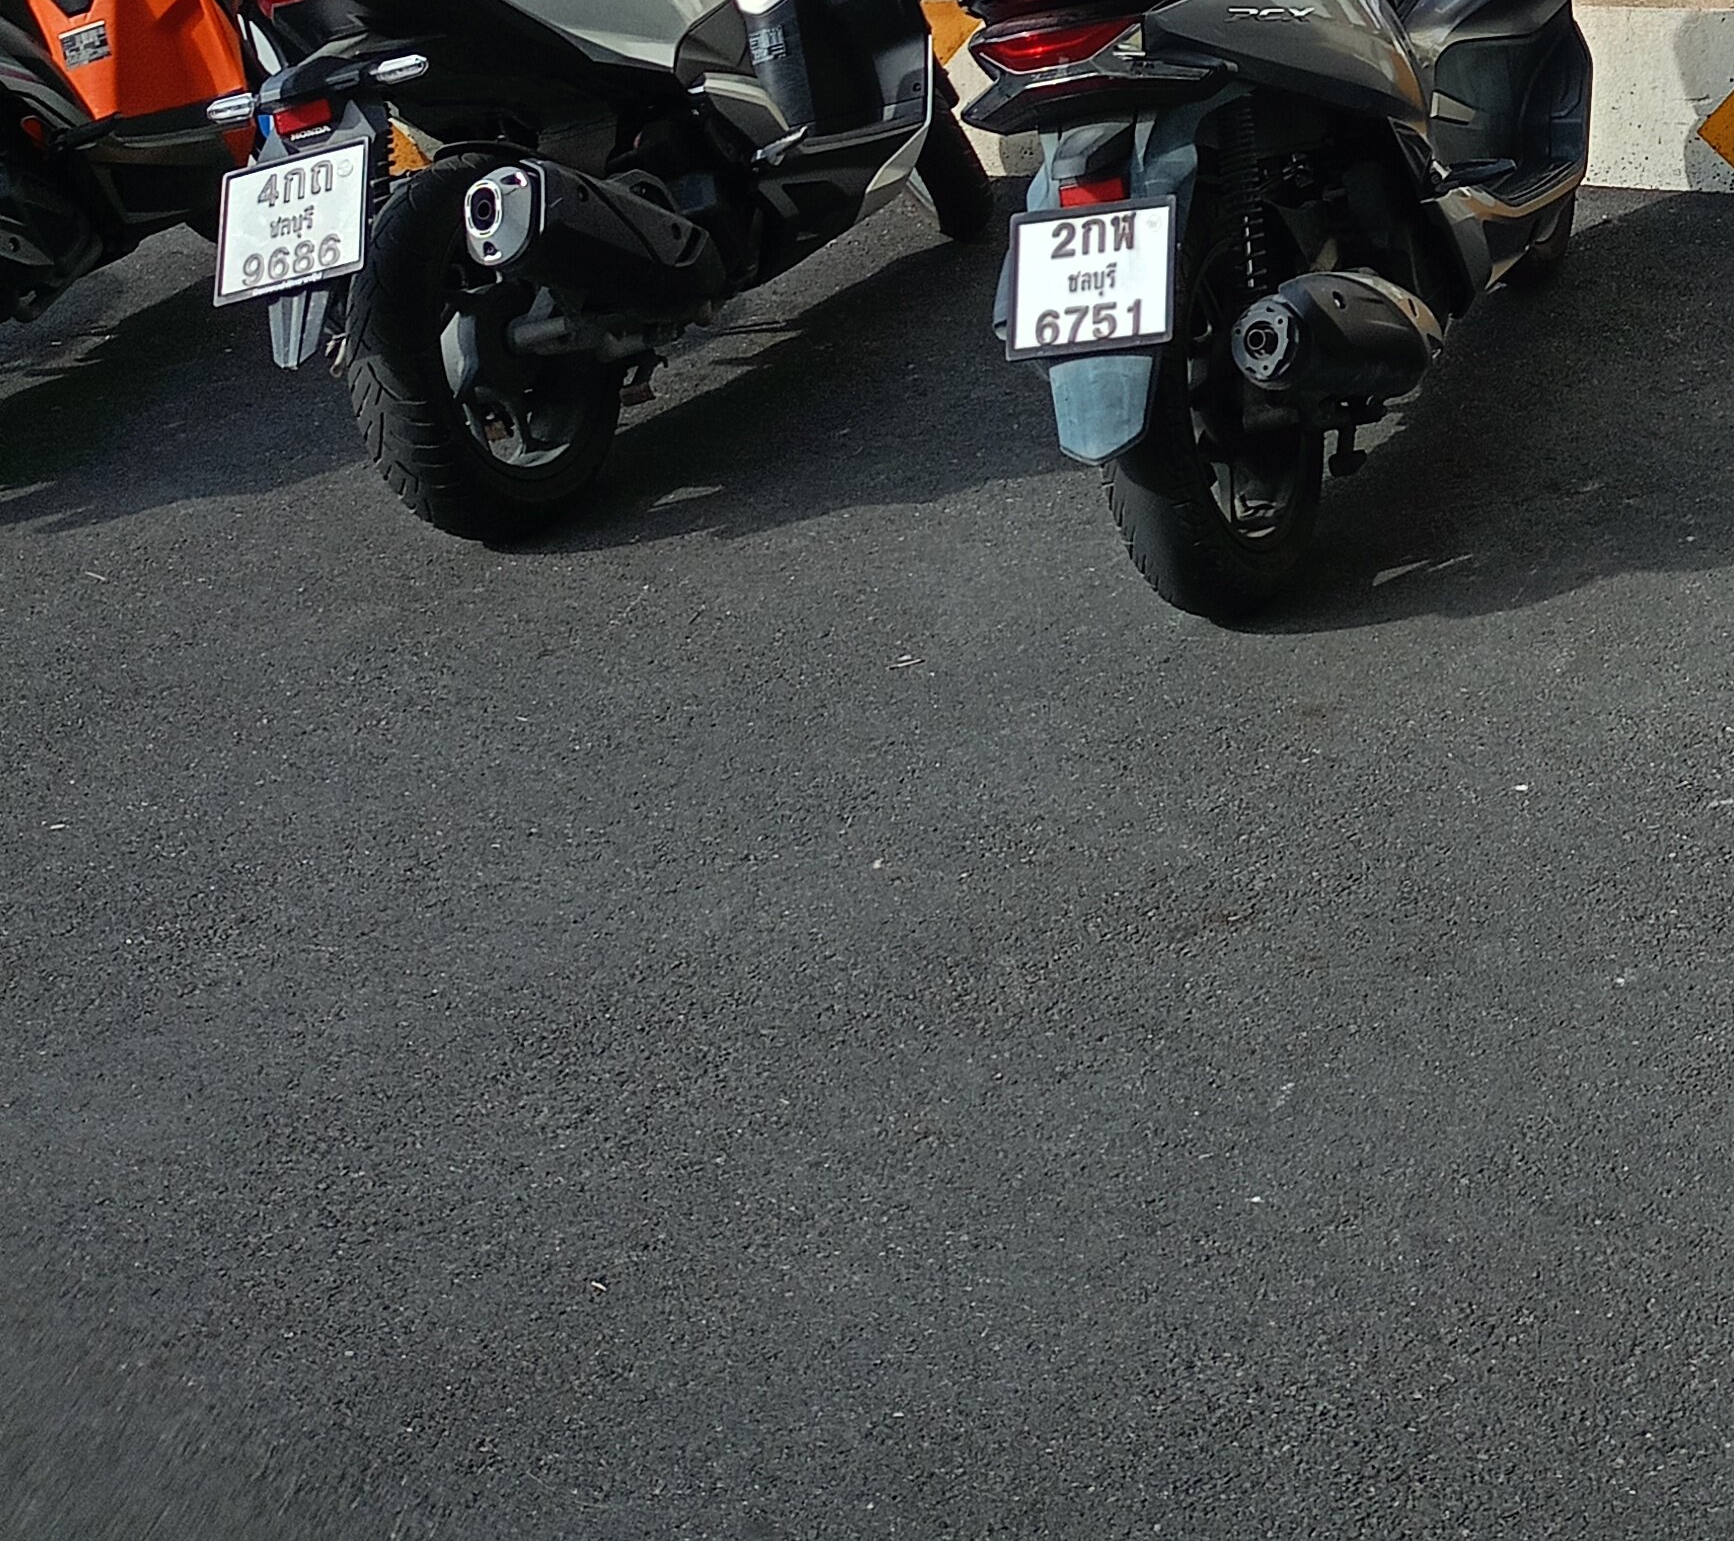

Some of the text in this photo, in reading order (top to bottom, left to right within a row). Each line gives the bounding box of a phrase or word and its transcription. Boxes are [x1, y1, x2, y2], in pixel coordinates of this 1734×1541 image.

[1225, 6, 1315, 23] PCX
[290, 125, 331, 142] HONDA
[258, 160, 334, 207] 4กถ
[270, 205, 315, 238] ชลบุรี
[242, 233, 341, 287] 9686
[1068, 262, 1117, 296] ชลบุรี
[1035, 298, 1142, 345] 6751
